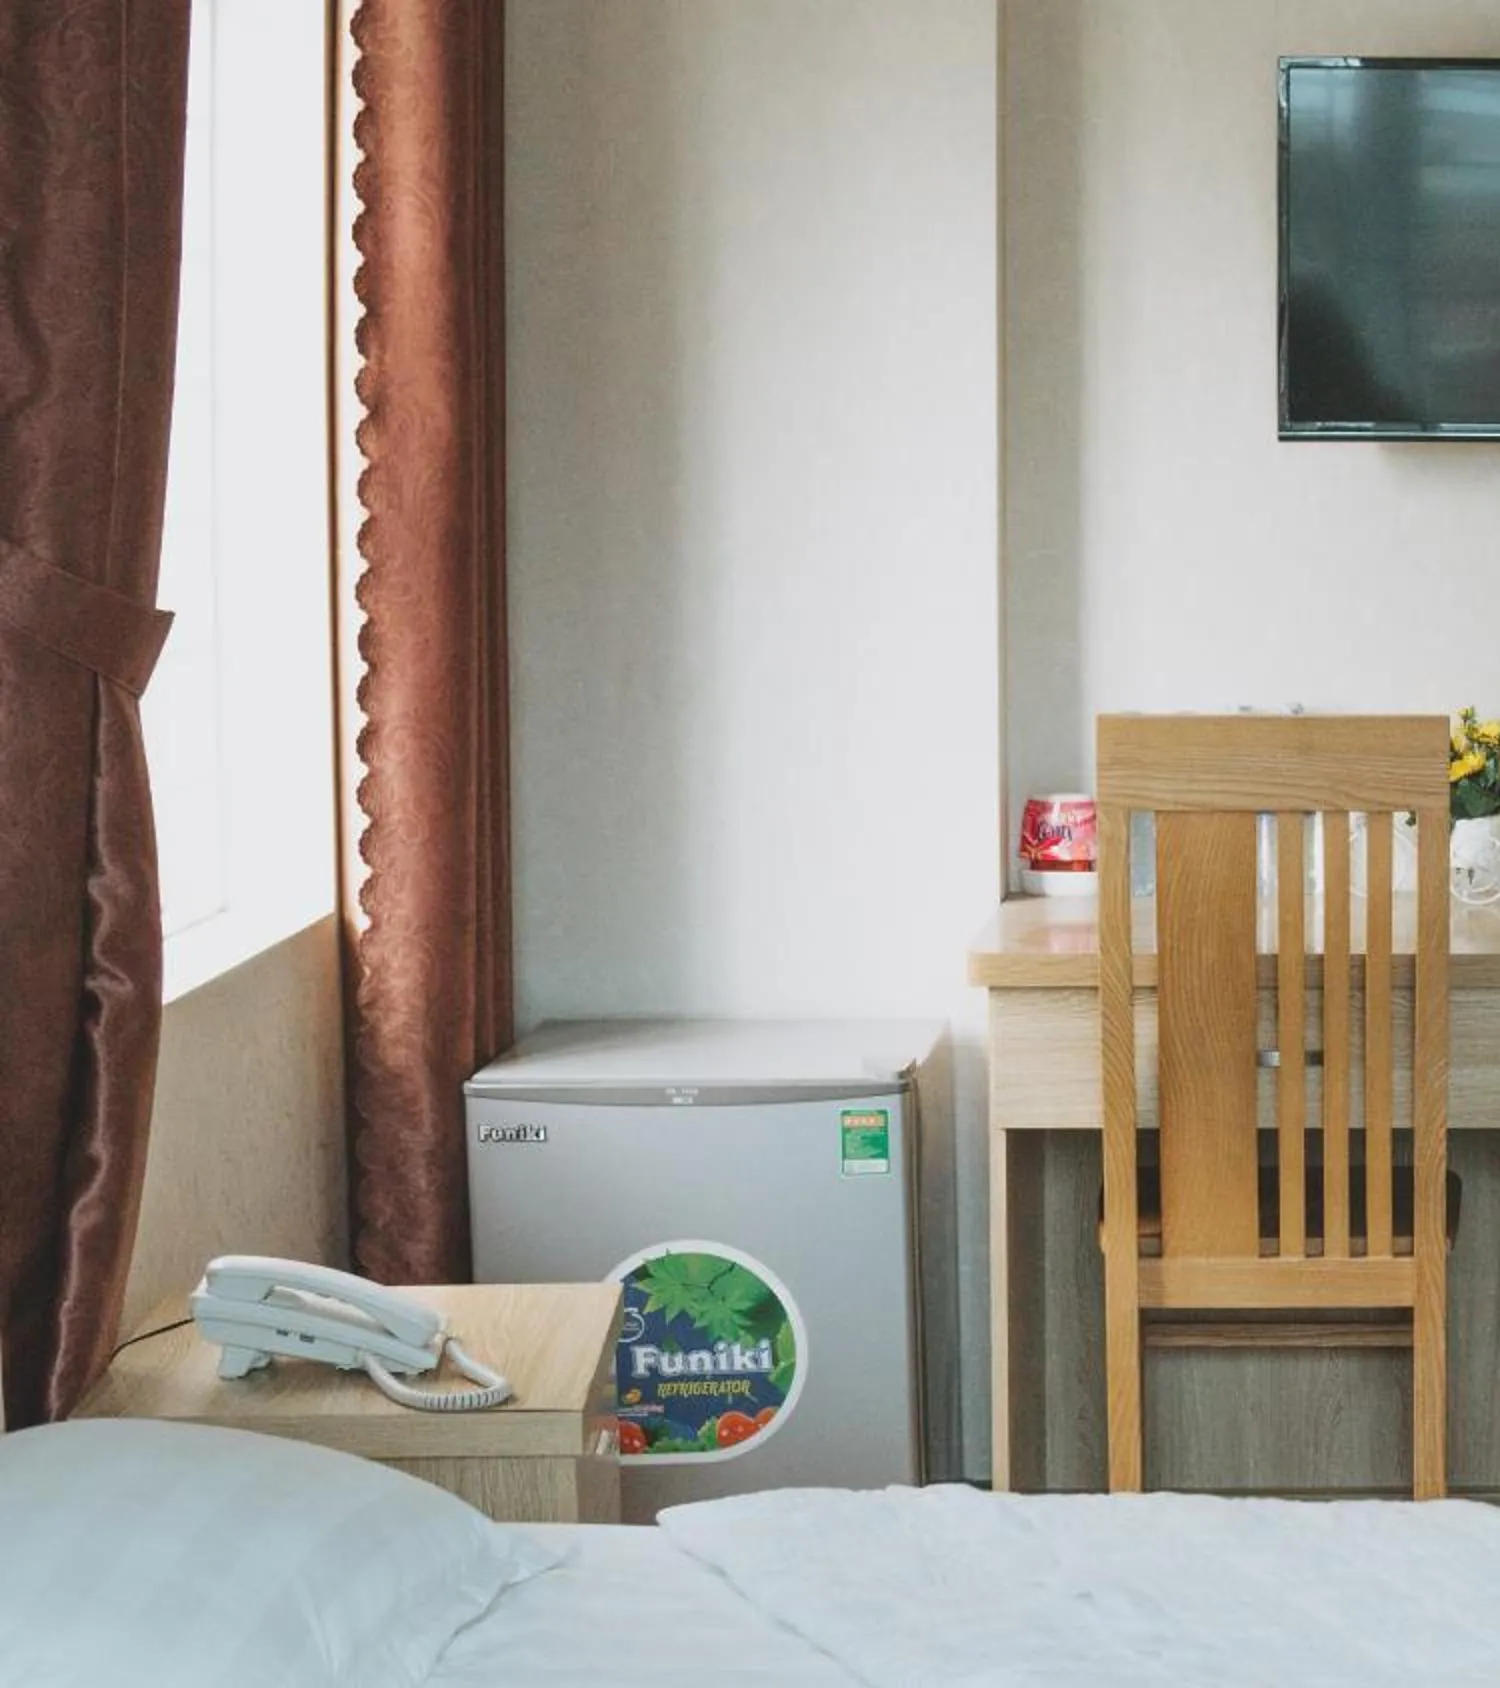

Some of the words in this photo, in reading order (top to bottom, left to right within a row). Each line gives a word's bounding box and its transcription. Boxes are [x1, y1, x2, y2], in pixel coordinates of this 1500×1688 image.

[479, 1124, 547, 1142] Funiki
[630, 1338, 773, 1378] Funiki
[657, 1380, 750, 1398] REFRIGERATOR
